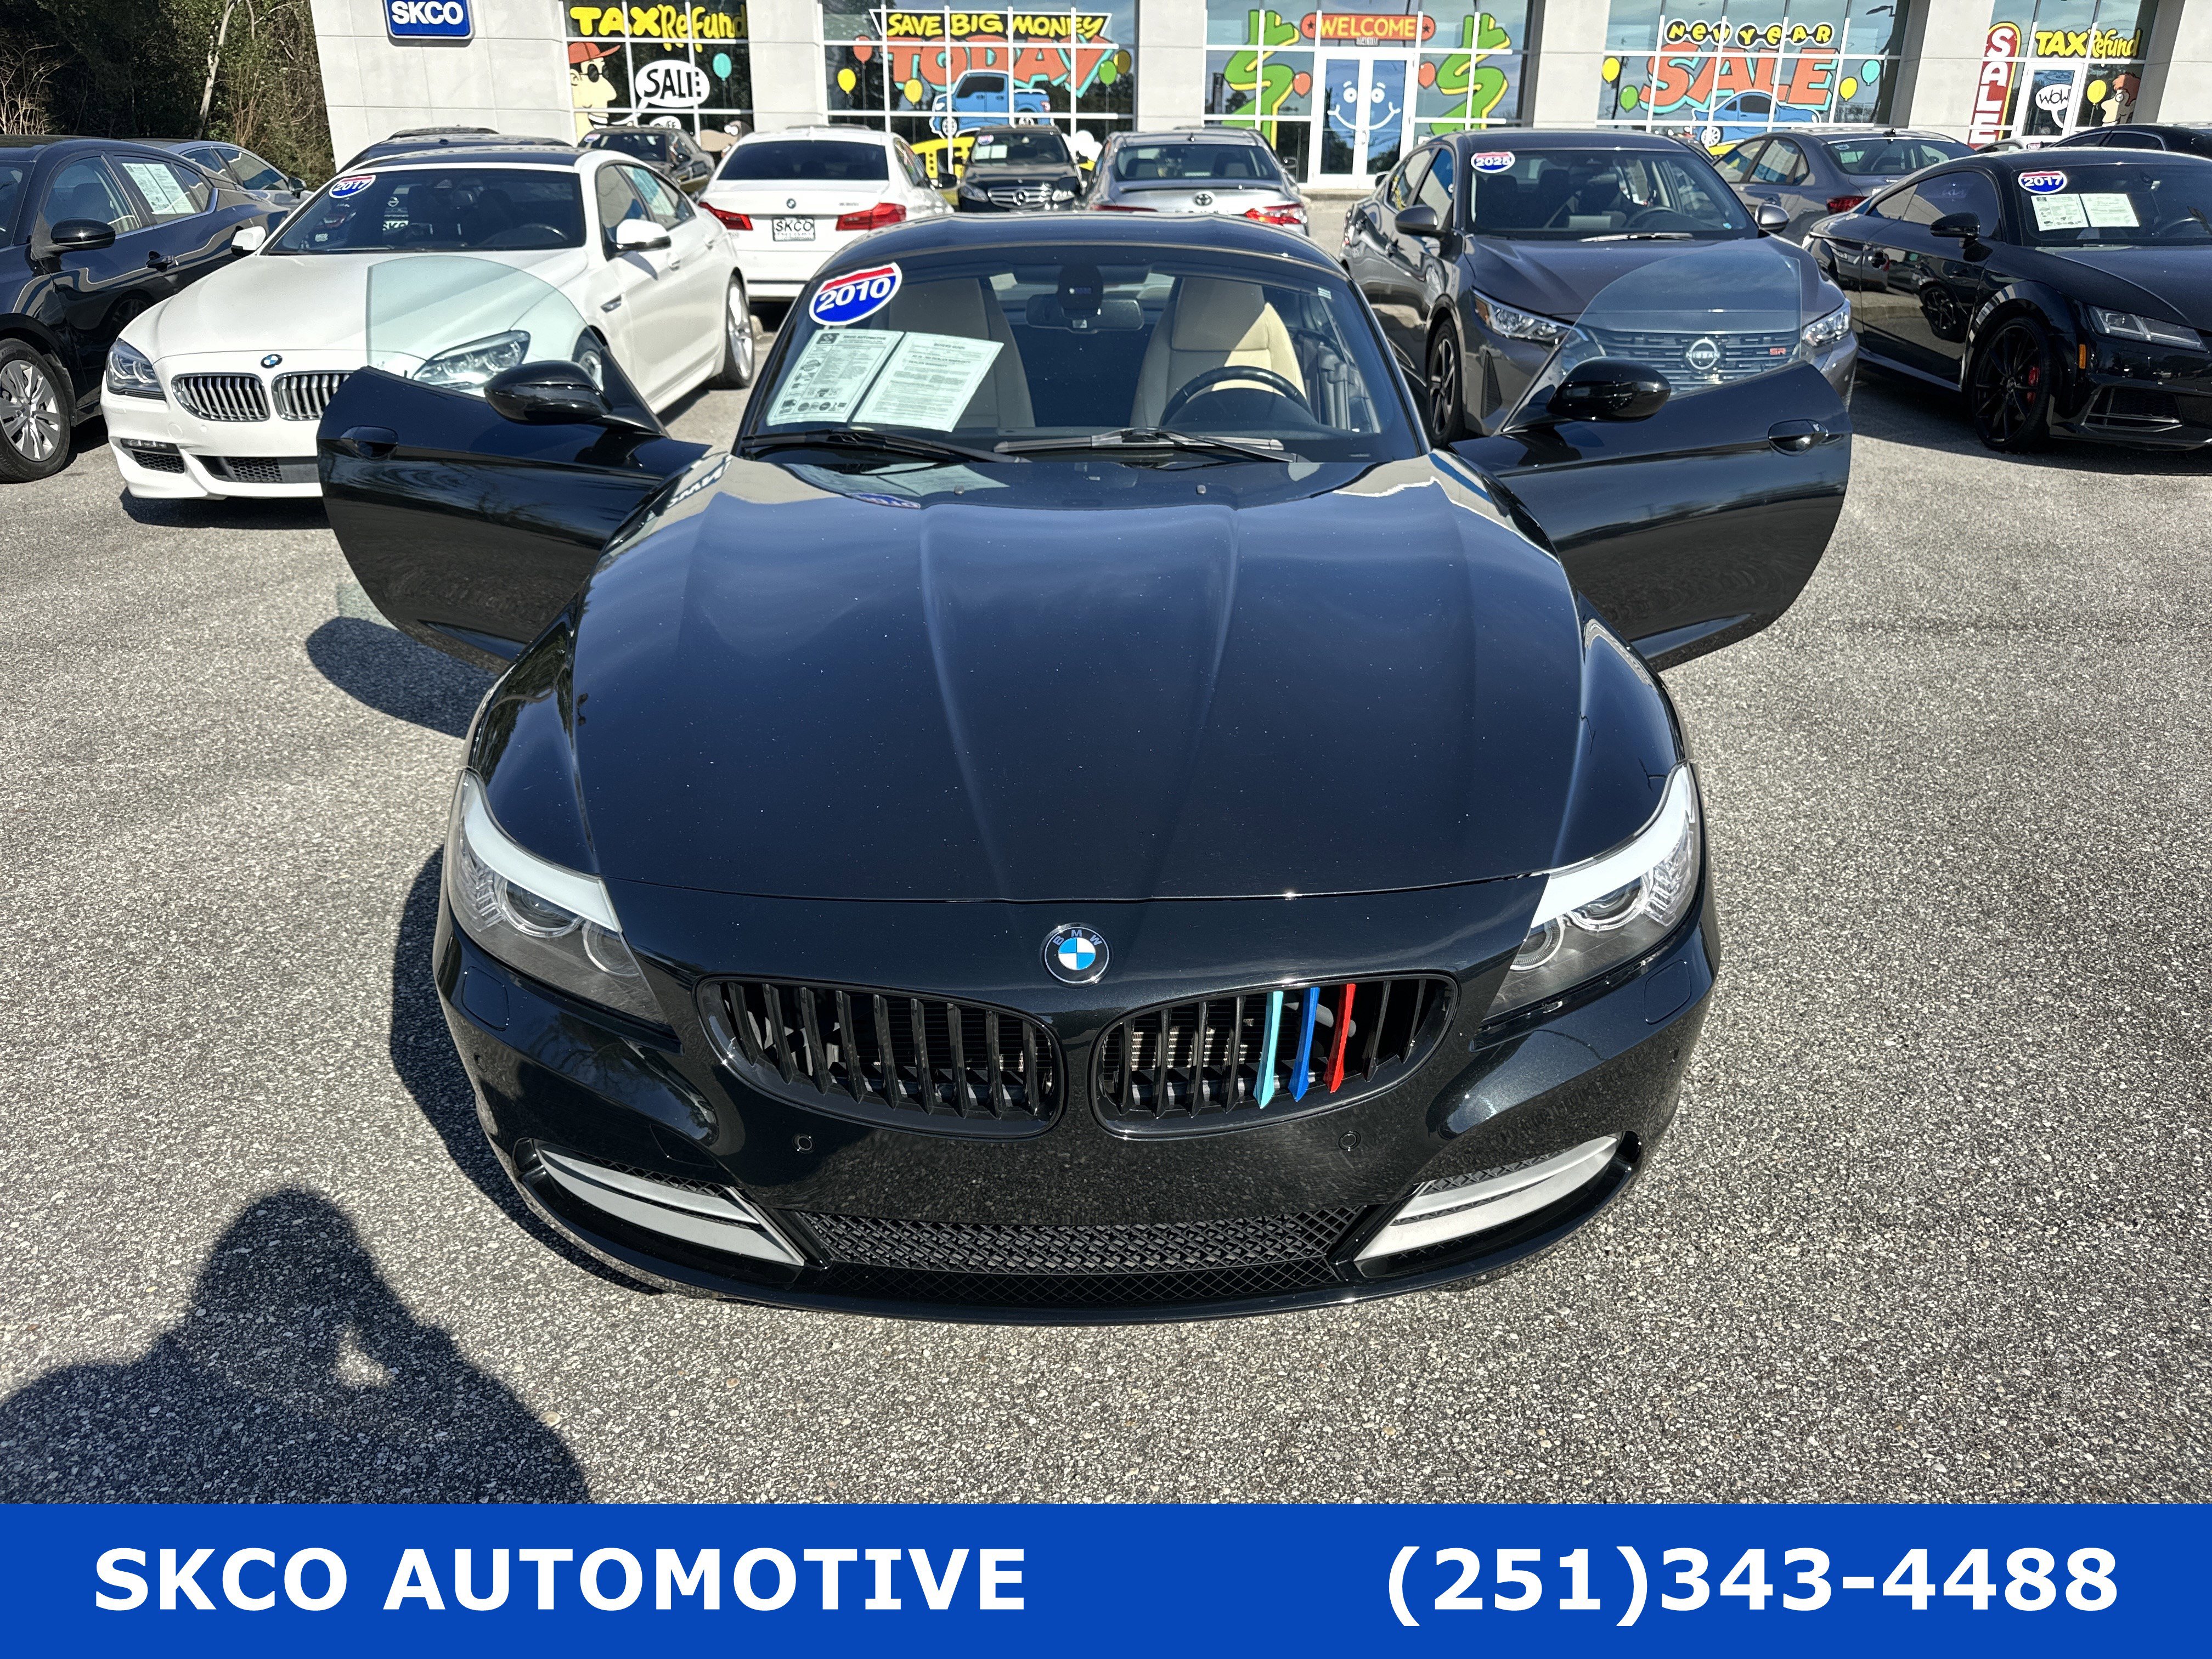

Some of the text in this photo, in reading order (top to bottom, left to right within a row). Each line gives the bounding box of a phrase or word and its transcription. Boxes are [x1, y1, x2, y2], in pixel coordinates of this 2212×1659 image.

[391, 1, 464, 25] SKCO
[570, 7, 661, 36] TAX
[887, 13, 1104, 39] SAVE BIG MONEY
[1321, 16, 1417, 37] WELCOME
[2035, 31, 2087, 56] TAX
[880, 35, 1114, 97] TODAY
[1639, 42, 1838, 113] SALE
[644, 69, 702, 99] SALE
[1969, 27, 2015, 144] SALE
[1475, 156, 1512, 166] 2025
[332, 180, 368, 192] 2017
[2024, 177, 2062, 187] 2017
[776, 221, 812, 232] SKCO
[816, 276, 891, 314] 2010
[1053, 929, 1102, 946] BMW
